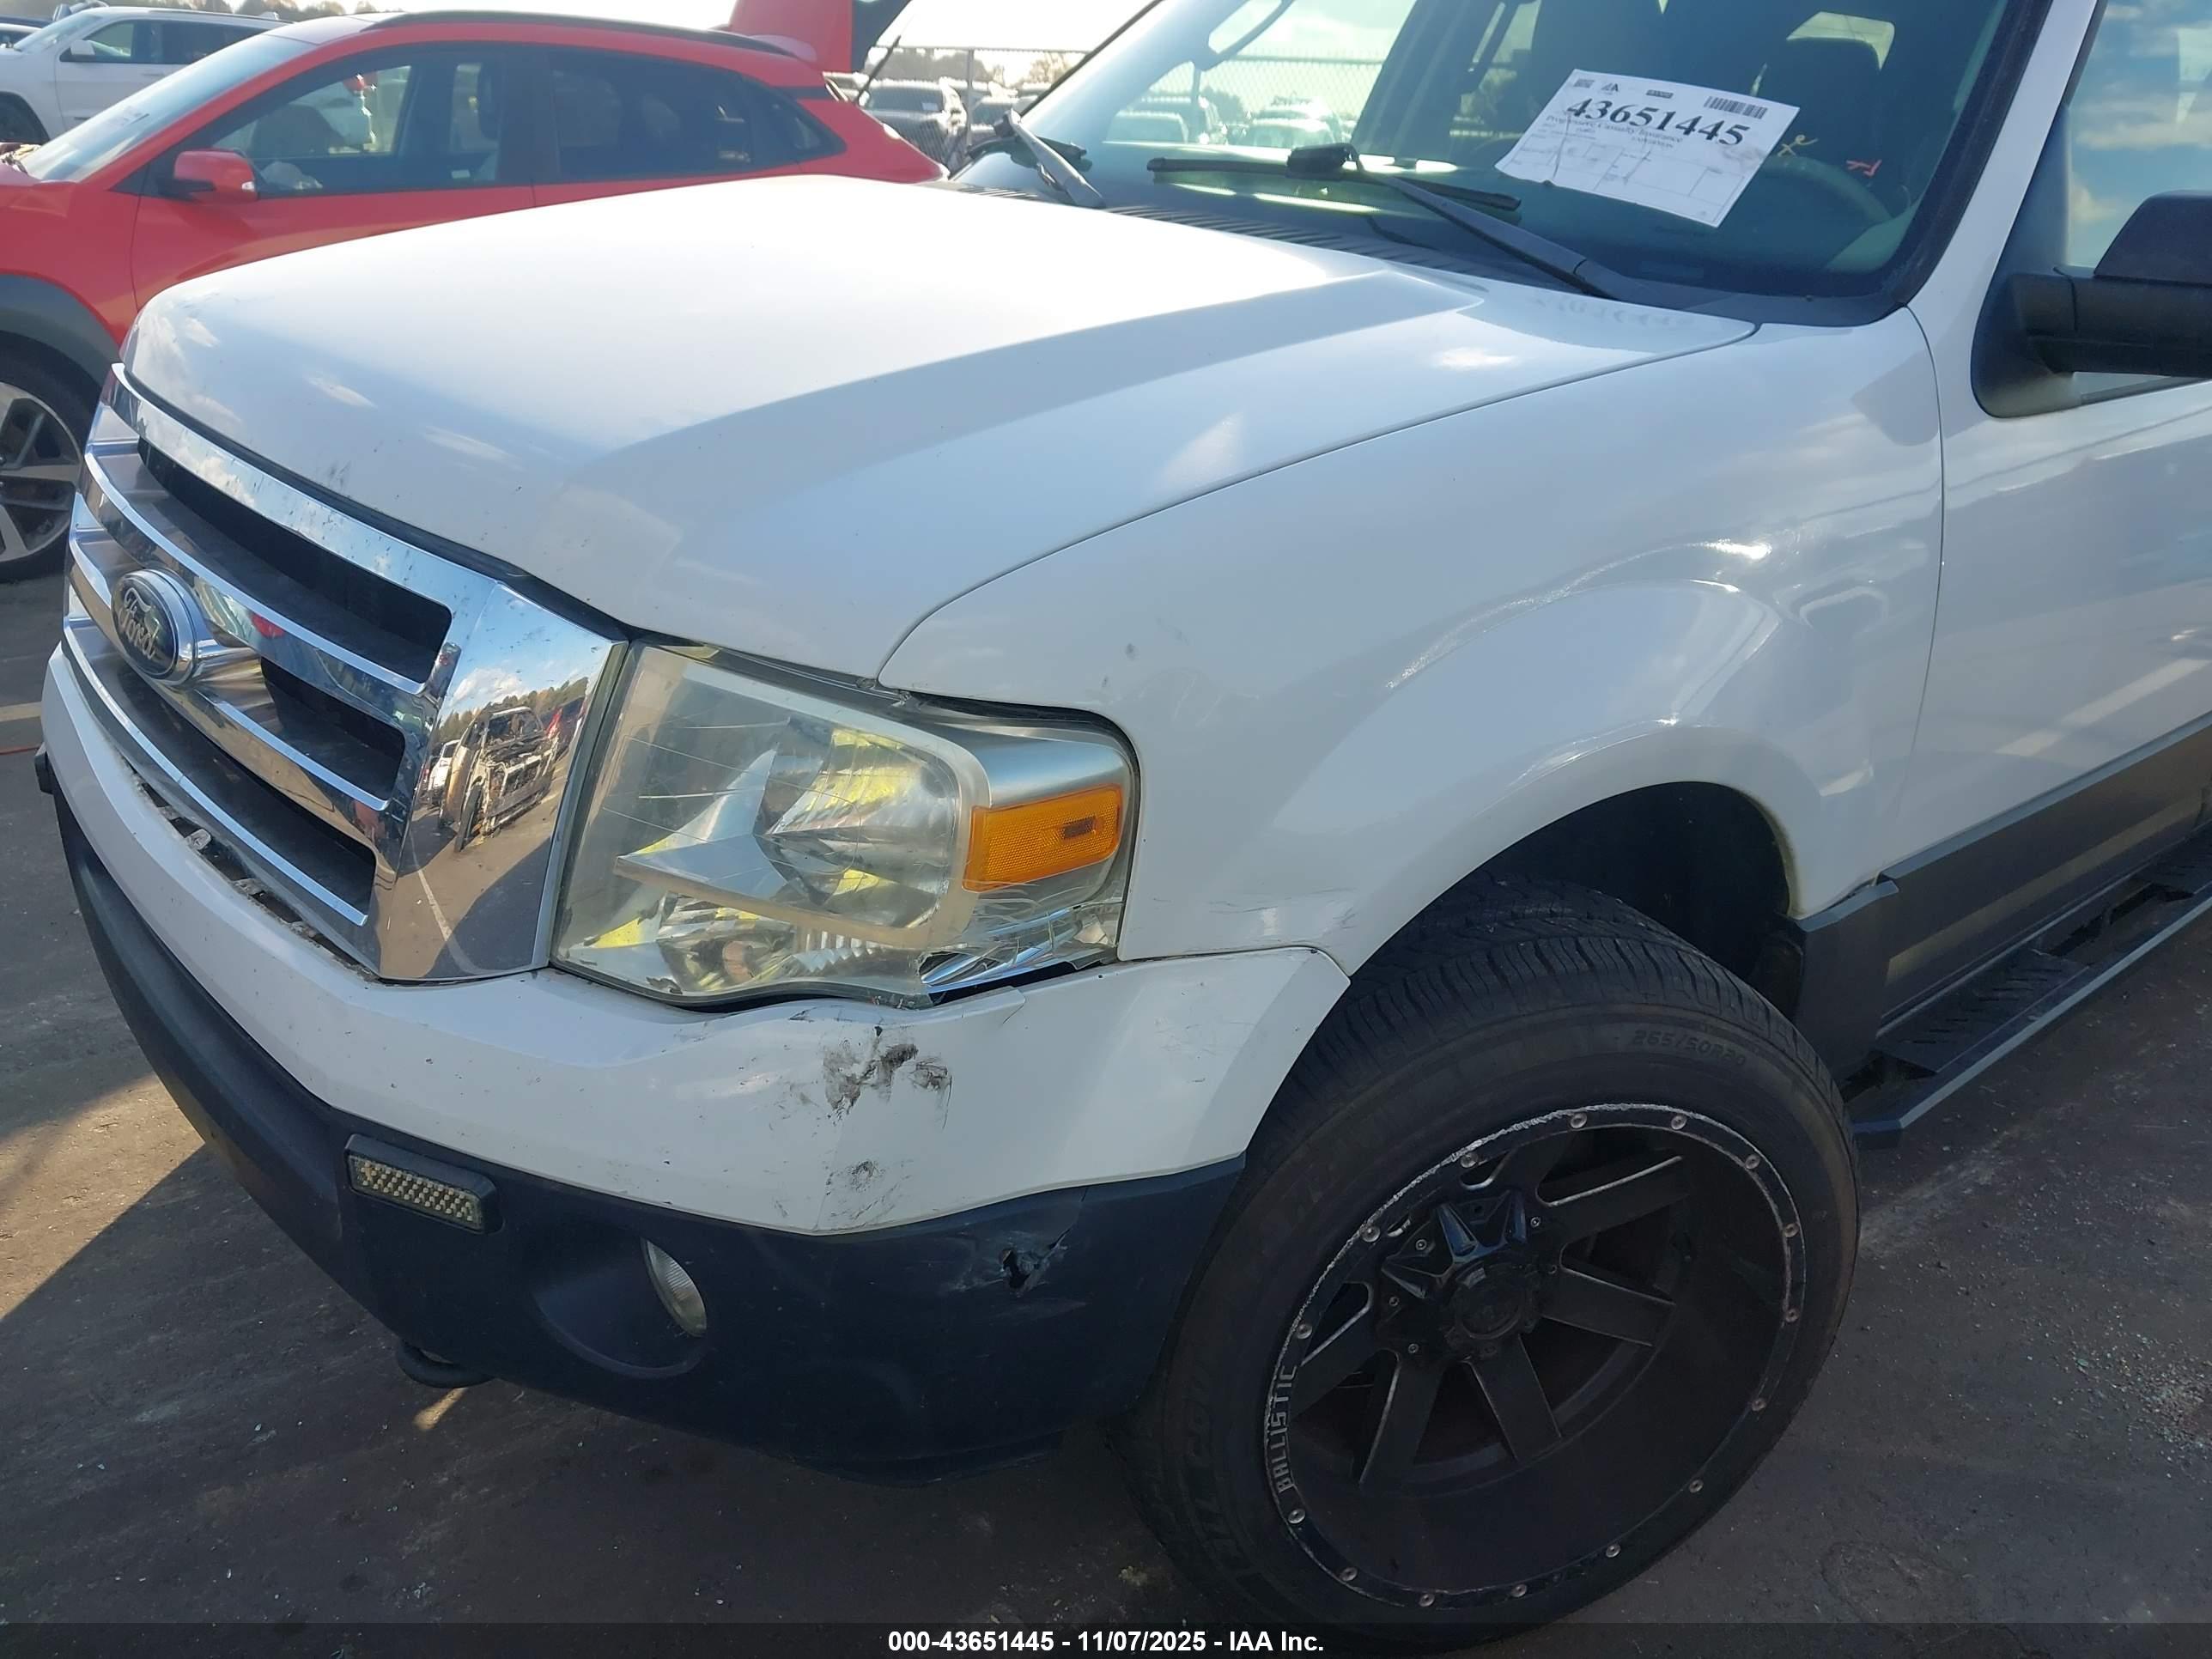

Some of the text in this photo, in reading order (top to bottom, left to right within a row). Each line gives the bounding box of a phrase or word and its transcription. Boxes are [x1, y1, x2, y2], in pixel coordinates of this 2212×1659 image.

[1567, 97, 1750, 146] 43651445
[118, 588, 160, 659] Ford
[1632, 1029, 1747, 1066] 265/50R20
[1269, 1364, 1297, 1494] BALLISTIC
